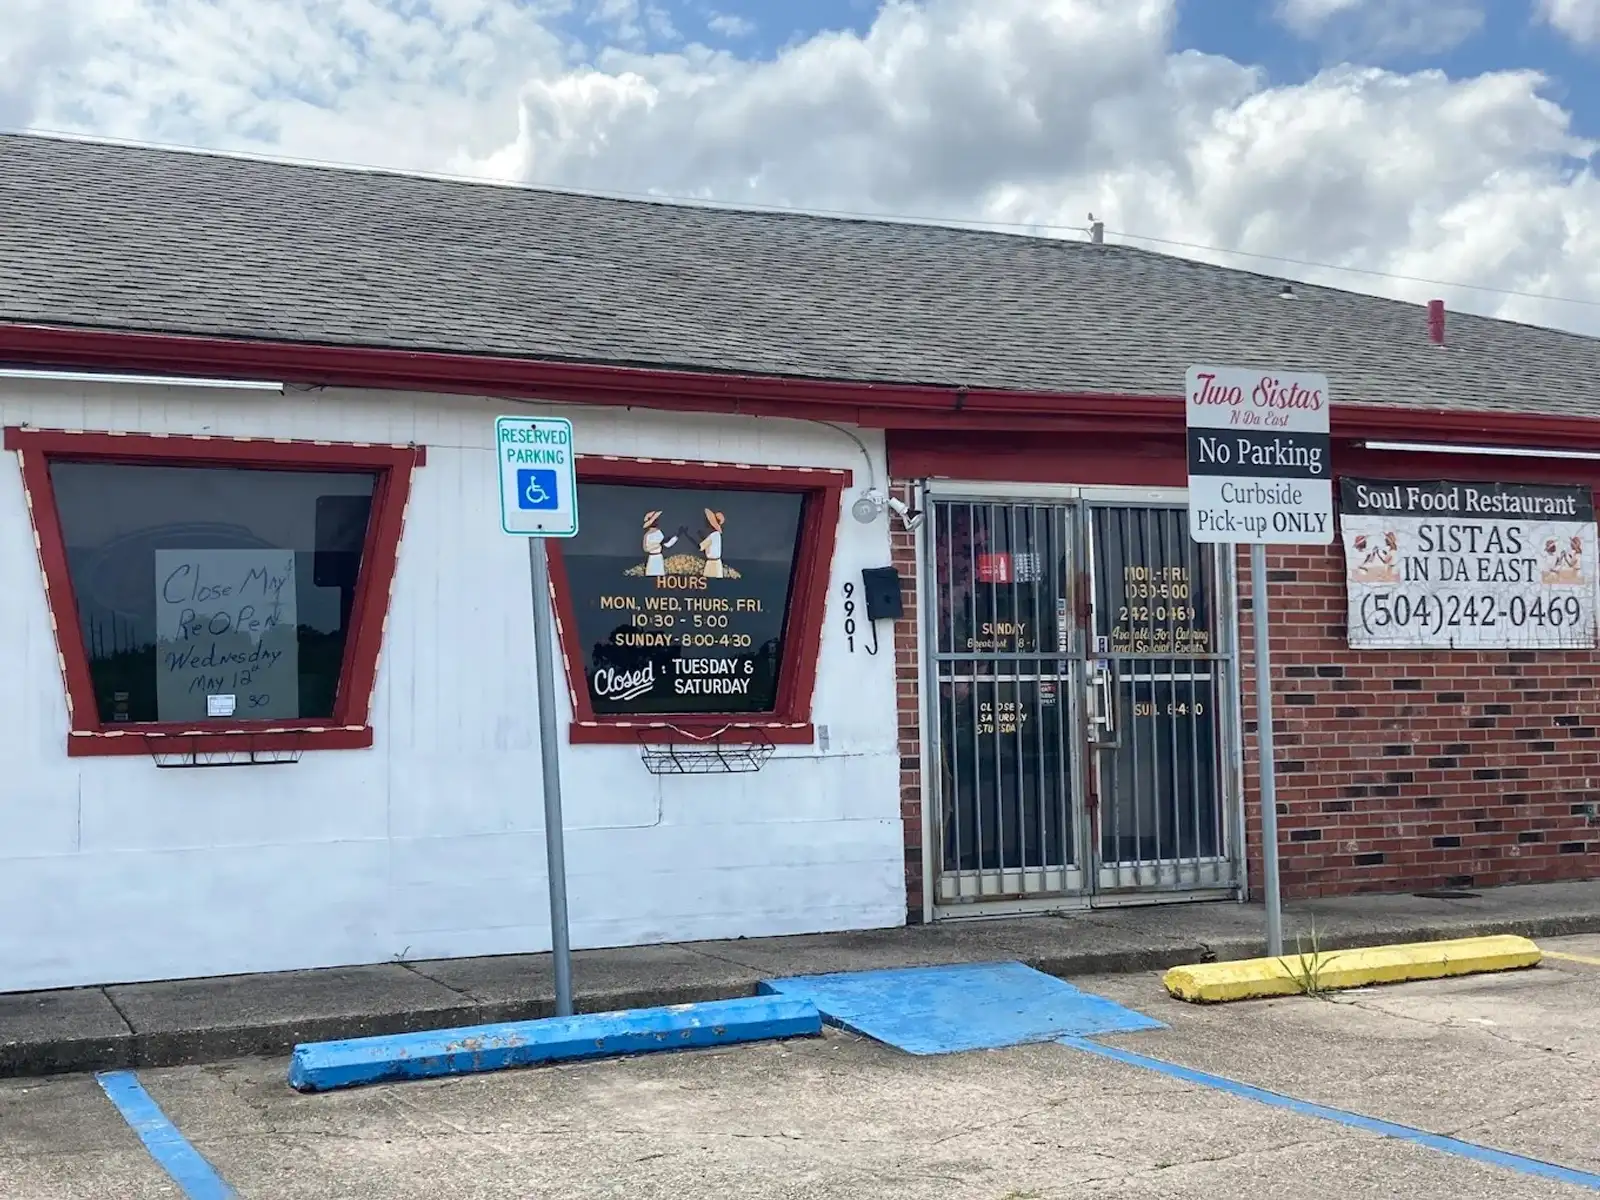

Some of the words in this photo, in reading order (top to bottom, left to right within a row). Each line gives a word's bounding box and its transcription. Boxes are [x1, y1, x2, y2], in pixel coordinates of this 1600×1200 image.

[1192, 373, 1243, 406] Two
[1252, 376, 1324, 411] Sistas
[1229, 409, 1240, 424] N
[1243, 411, 1261, 425] Da
[1264, 411, 1290, 427] East
[501, 428, 568, 445] RESERVED
[507, 448, 564, 465] PARKING
[1198, 437, 1231, 464] No
[1237, 438, 1323, 474] Parking
[1220, 482, 1303, 505] Curbside
[1357, 485, 1403, 510] Soul
[1406, 487, 1460, 512] Food
[1465, 488, 1577, 515] Restaurant
[1197, 509, 1268, 538] Pick-up
[1272, 511, 1328, 533] ONLY
[1418, 524, 1522, 555] SISTAS
[1404, 556, 1429, 582] IN
[1439, 557, 1474, 582] DA
[1476, 558, 1537, 583] EAST
[163, 564, 233, 604] Close
[656, 575, 708, 590] HOURS
[736, 599, 764, 613] FRI.
[1361, 593, 1581, 636] (504)242-0469
[843, 582, 856, 653] 9901
[615, 633, 673, 647] SUNDAY
[1175, 626, 1208, 644] Catring
[1136, 640, 1170, 653] Spcial
[594, 660, 655, 696] Closed
[672, 658, 738, 675] TUESDAY
[674, 678, 751, 695] SATURDAY
[980, 713, 1028, 723] SAURDY
[983, 723, 1024, 734] TUSDA
